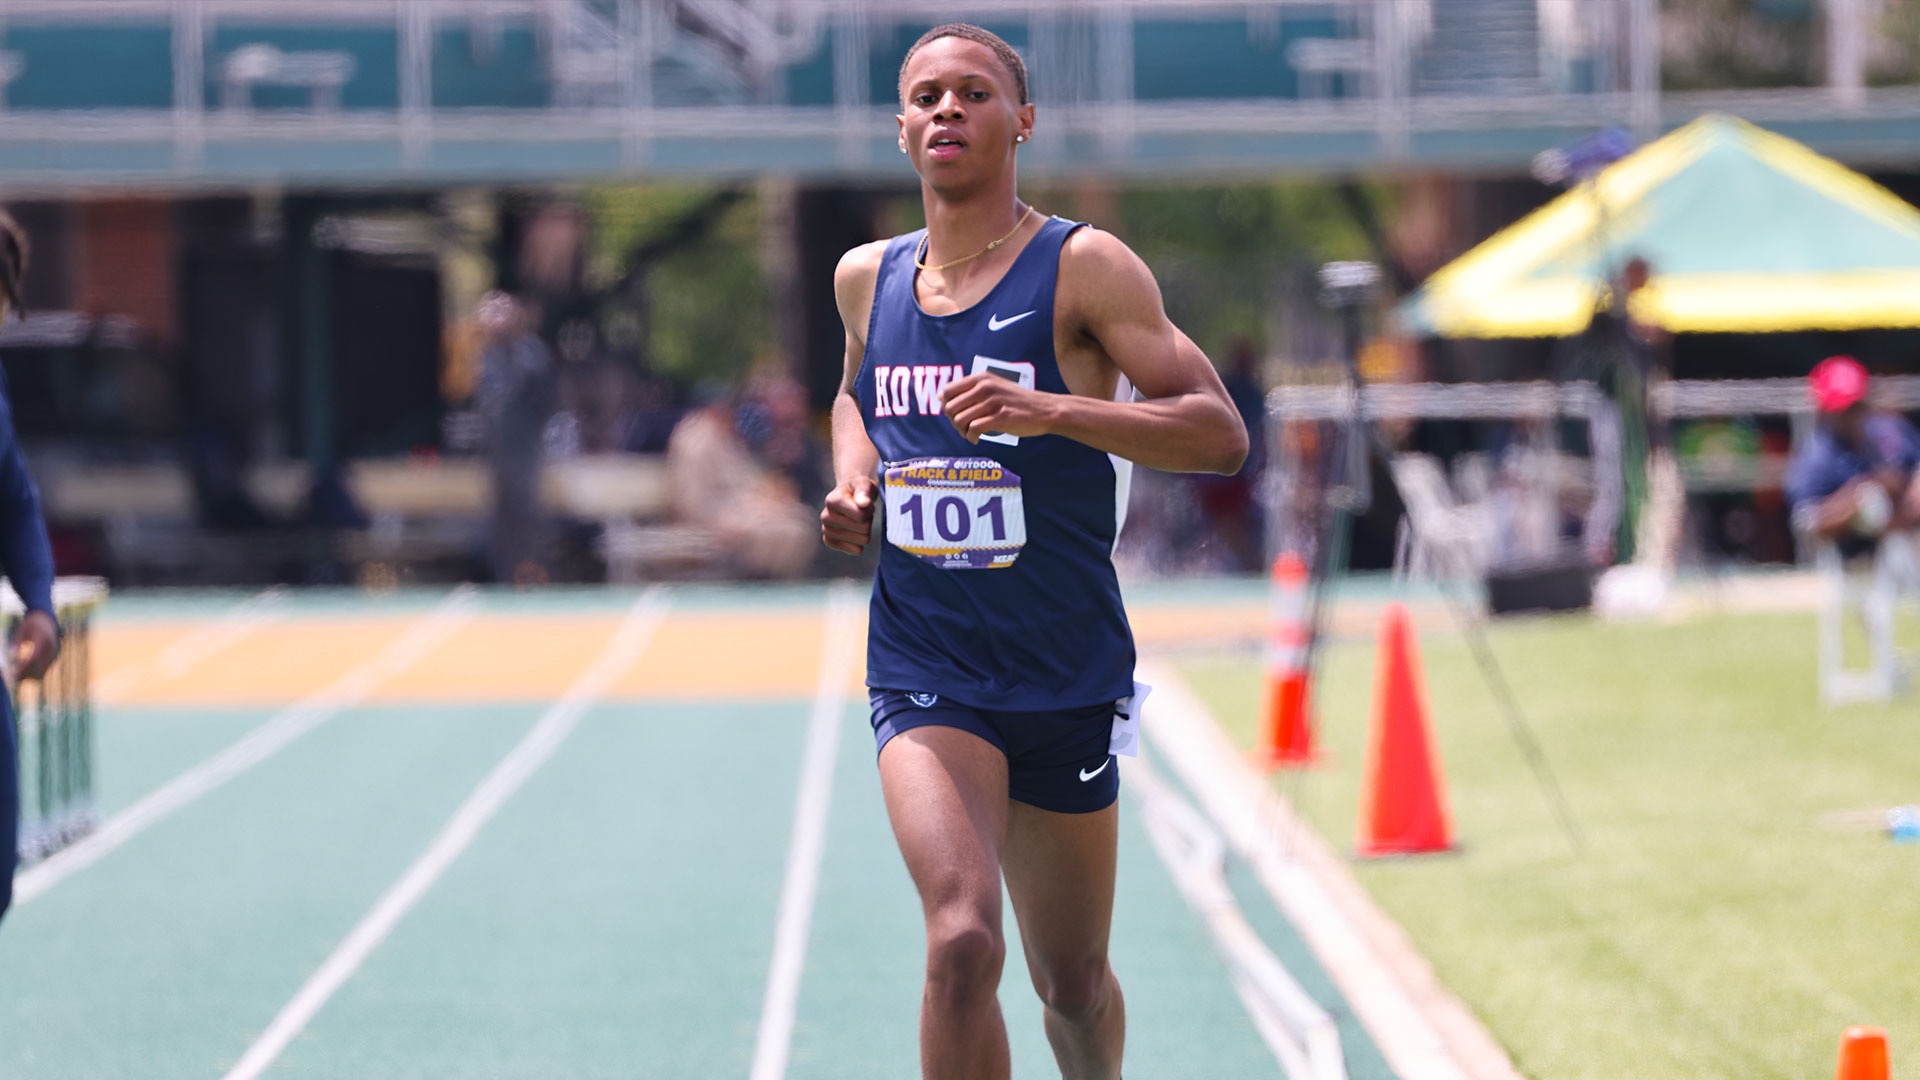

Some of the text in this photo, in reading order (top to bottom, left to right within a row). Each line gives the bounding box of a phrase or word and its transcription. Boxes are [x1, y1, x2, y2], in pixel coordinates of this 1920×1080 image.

[901, 467, 1003, 481] TRACK & FIELD
[900, 494, 1007, 543] 101
